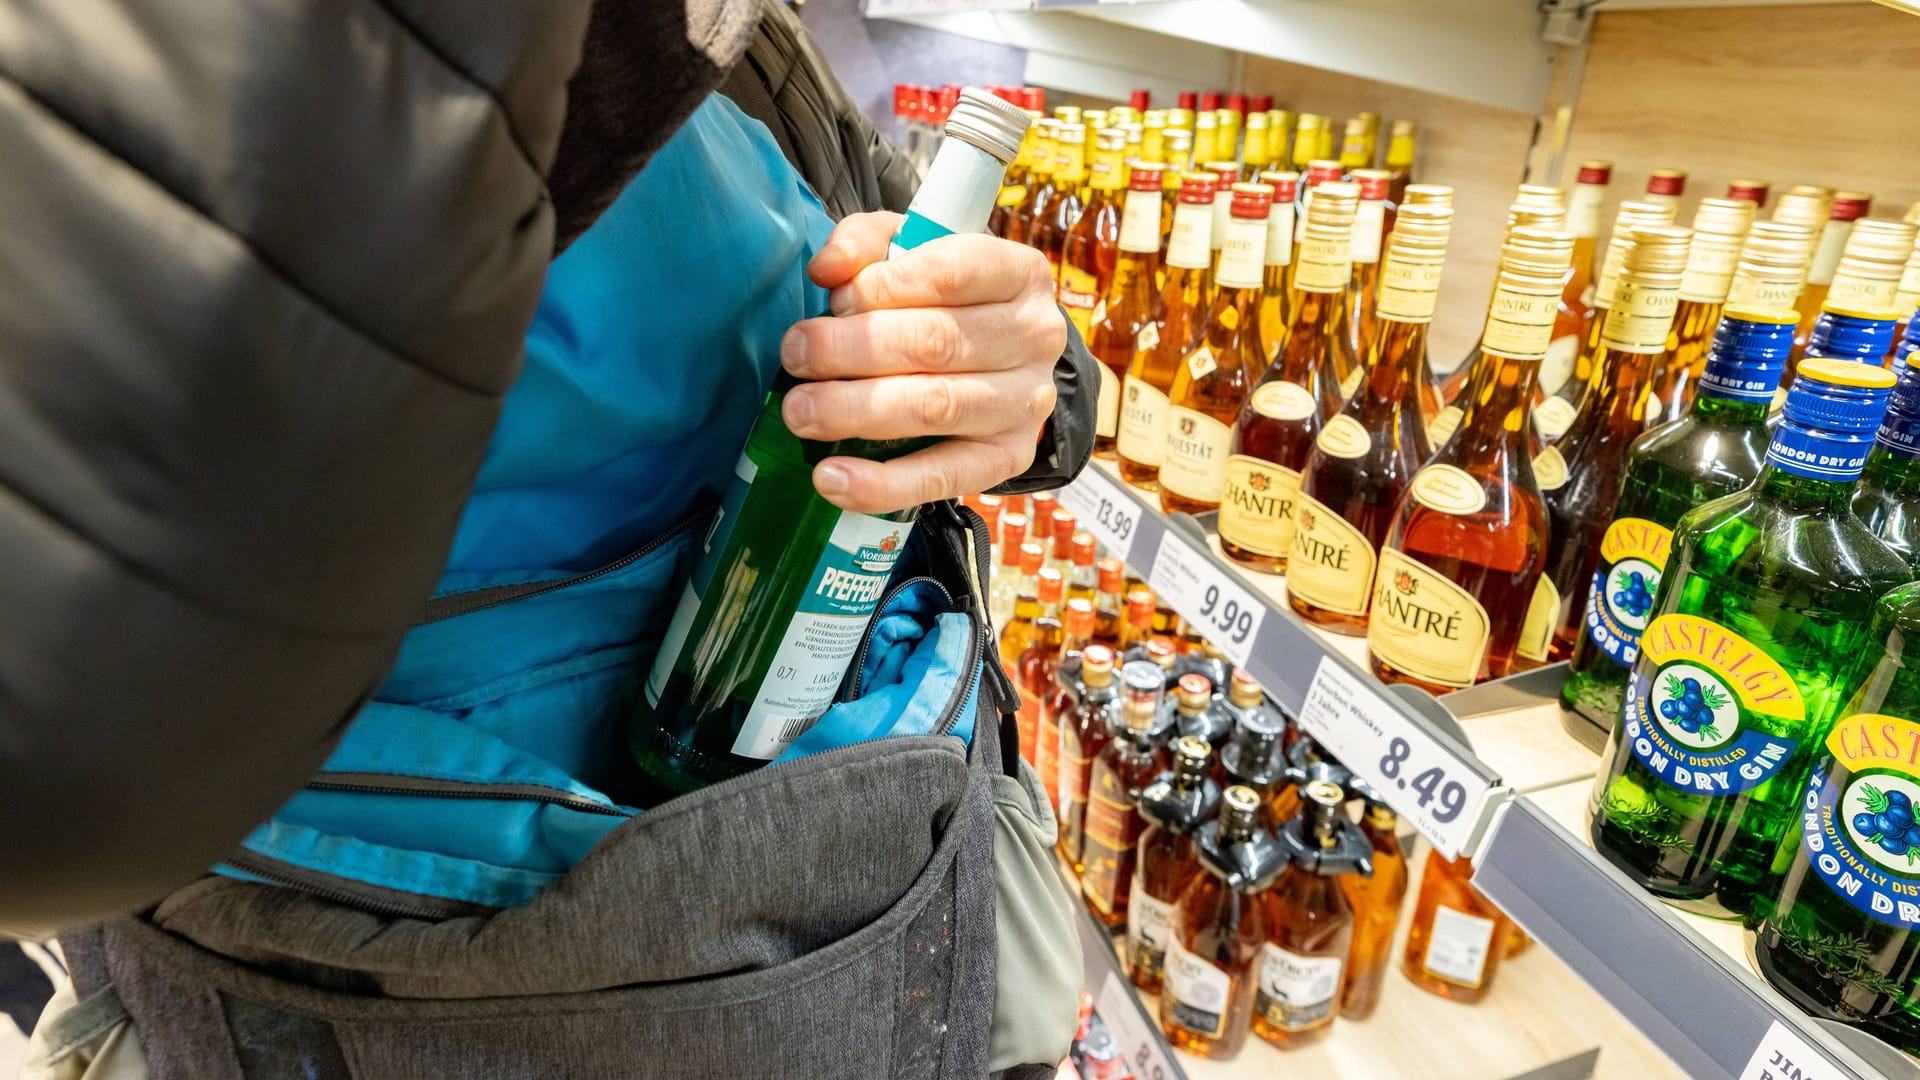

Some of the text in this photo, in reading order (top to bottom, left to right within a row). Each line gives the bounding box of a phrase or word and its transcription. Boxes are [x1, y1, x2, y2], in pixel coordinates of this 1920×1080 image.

[1721, 377, 1743, 389] DRY
[1745, 381, 1766, 391] GIN
[1771, 440, 1817, 463] LONDON
[1819, 454, 1847, 467] DRY
[1892, 431, 1914, 444] GIN
[1097, 498, 1132, 540] 13.99
[1605, 523, 1669, 562] CASTE
[1200, 584, 1253, 644] 9.99
[1649, 621, 1793, 703] CASTELGY
[1625, 671, 1788, 791] LONDON DRY GIN
[1637, 695, 1747, 768] TRADITIONALLY DISTILLED
[1379, 736, 1467, 824] 8.49
[1804, 774, 1920, 924] LONDON DR
[1822, 804, 1888, 887] TRADITIONALLY
